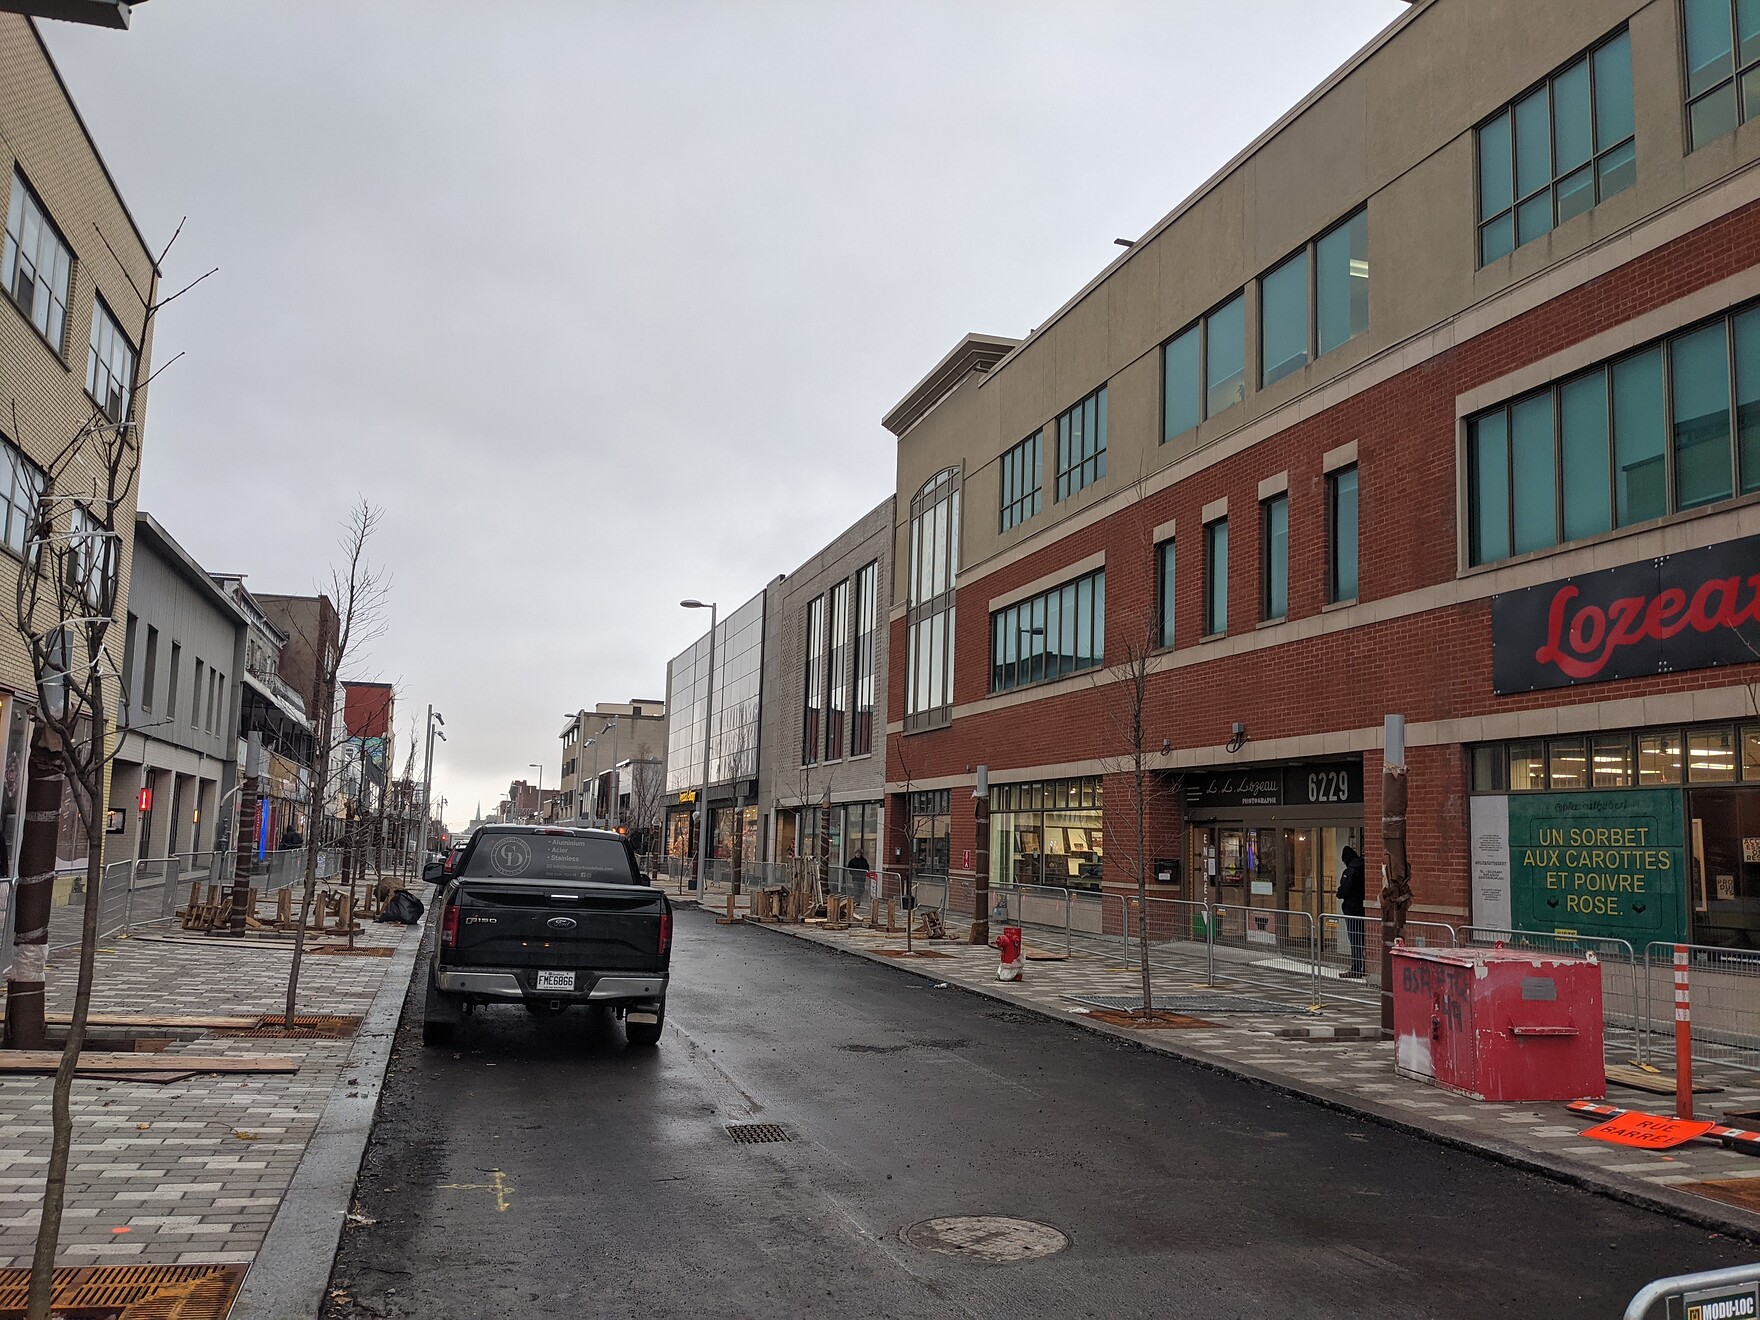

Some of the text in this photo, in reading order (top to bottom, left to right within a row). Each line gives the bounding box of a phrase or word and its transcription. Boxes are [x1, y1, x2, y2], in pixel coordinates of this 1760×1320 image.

[1308, 771, 1349, 802] 6229
[1242, 796, 1277, 805] PHOTOGRAPHE
[1539, 827, 1649, 847] UN SORBET
[1523, 850, 1671, 870] AUX CAROTTES
[1546, 872, 1646, 893] ET POIVRE
[1567, 895, 1624, 916] ROSE.
[1635, 1120, 1681, 1134] RUE
